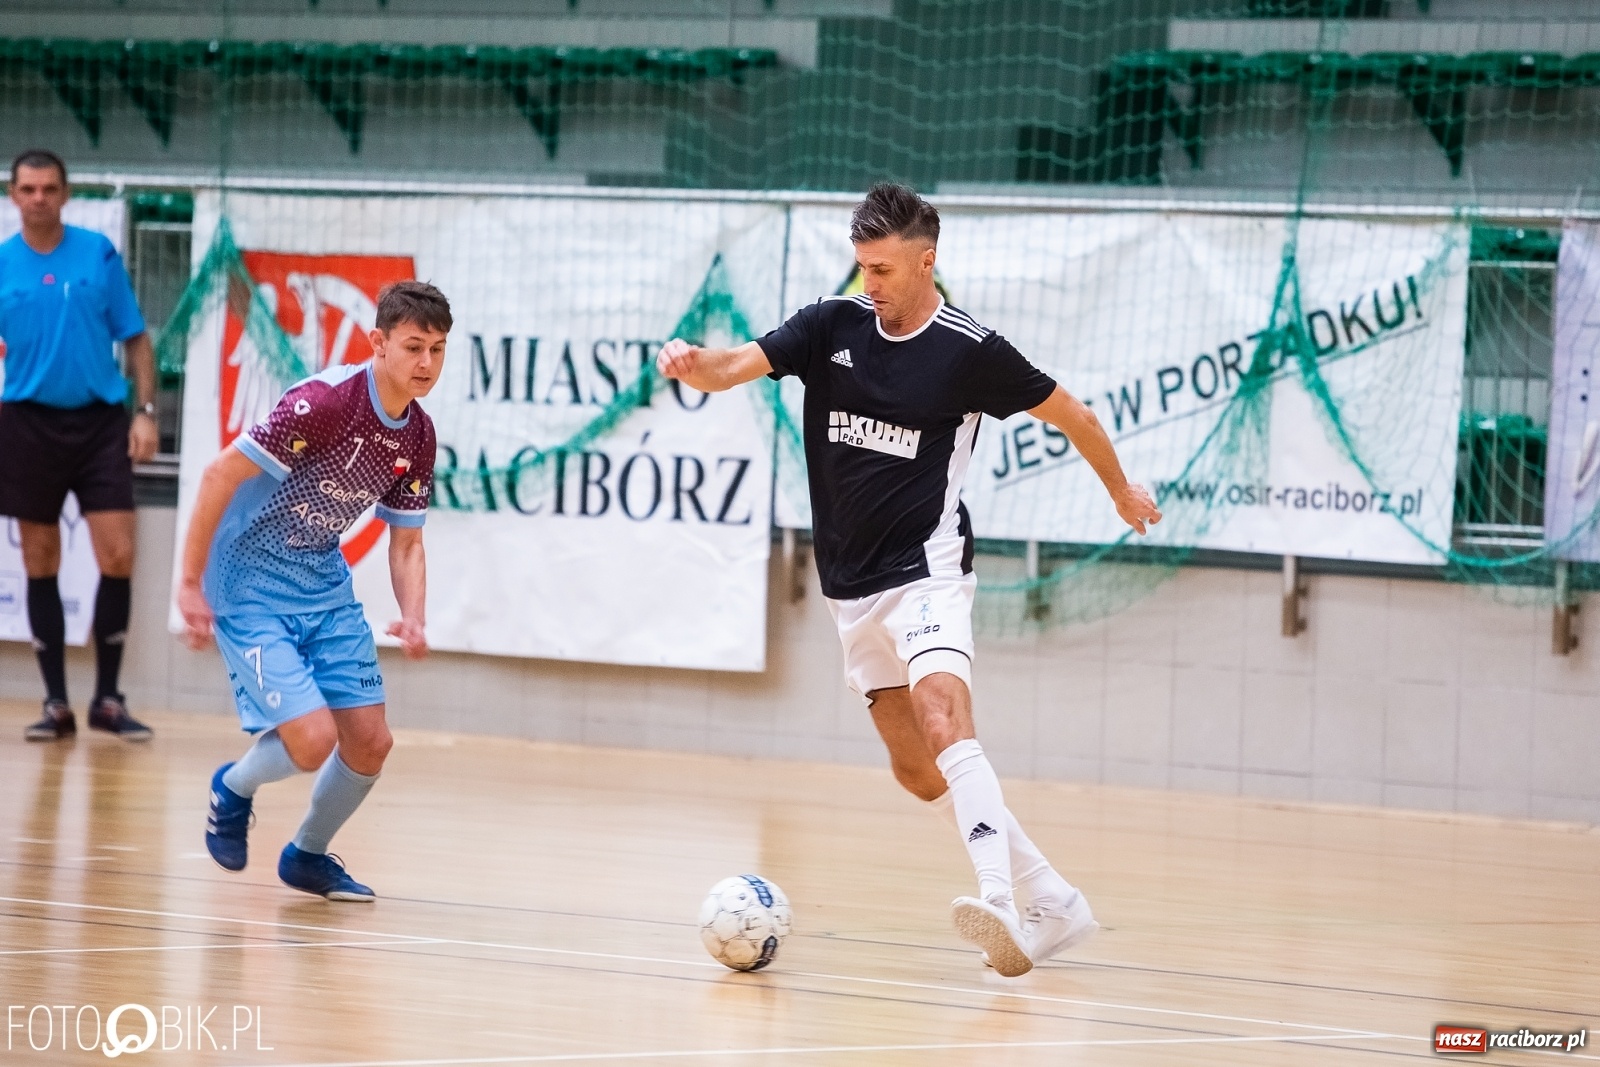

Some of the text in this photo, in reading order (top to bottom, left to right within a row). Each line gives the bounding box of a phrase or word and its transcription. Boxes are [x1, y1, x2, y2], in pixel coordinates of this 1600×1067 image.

[344, 436, 365, 471] 7
[850, 414, 922, 447] KUHN
[993, 400, 1094, 479] JES
[1106, 379, 1143, 432] W
[430, 431, 753, 526] RACIBÓRZ
[243, 643, 265, 692] 7
